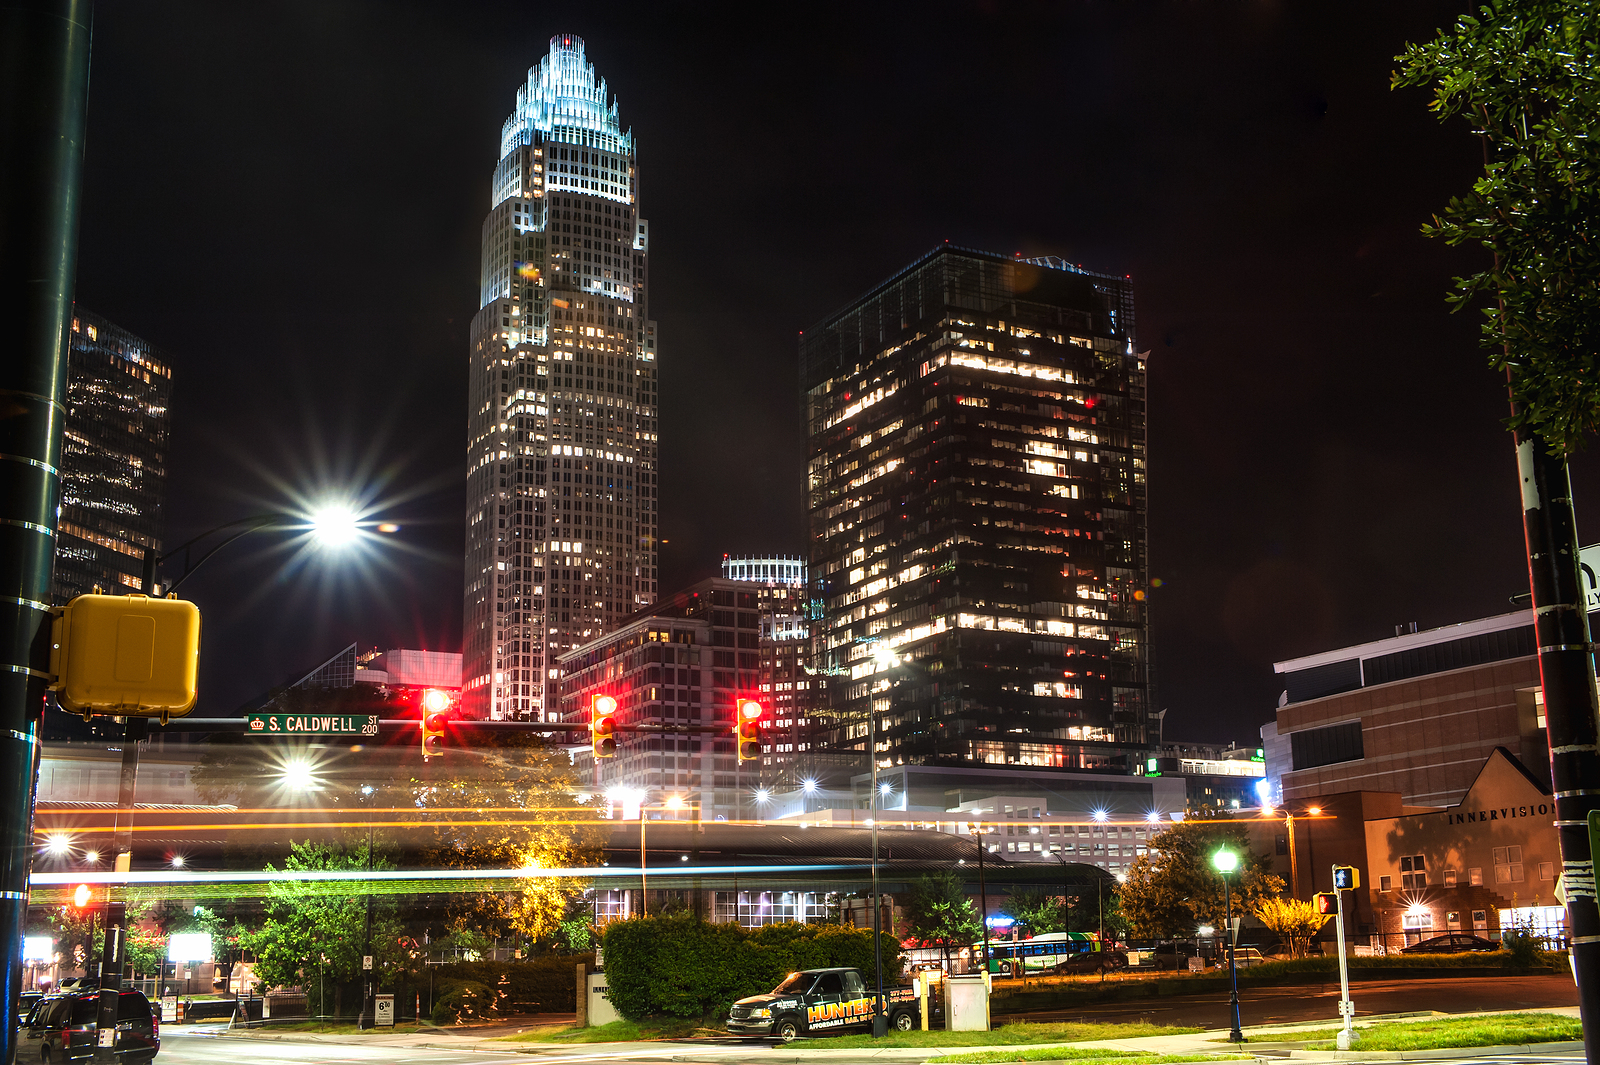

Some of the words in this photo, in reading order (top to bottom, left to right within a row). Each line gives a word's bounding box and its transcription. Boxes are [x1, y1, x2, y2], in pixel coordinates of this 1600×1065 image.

[1588, 592, 1600, 605] LY
[269, 716, 281, 731] S.
[286, 716, 356, 731] CALDWELL
[368, 715, 378, 724] ST
[361, 724, 378, 734] 200
[807, 994, 888, 1024] HUNTER'S
[808, 1018, 844, 1031] AFFORDABLE
